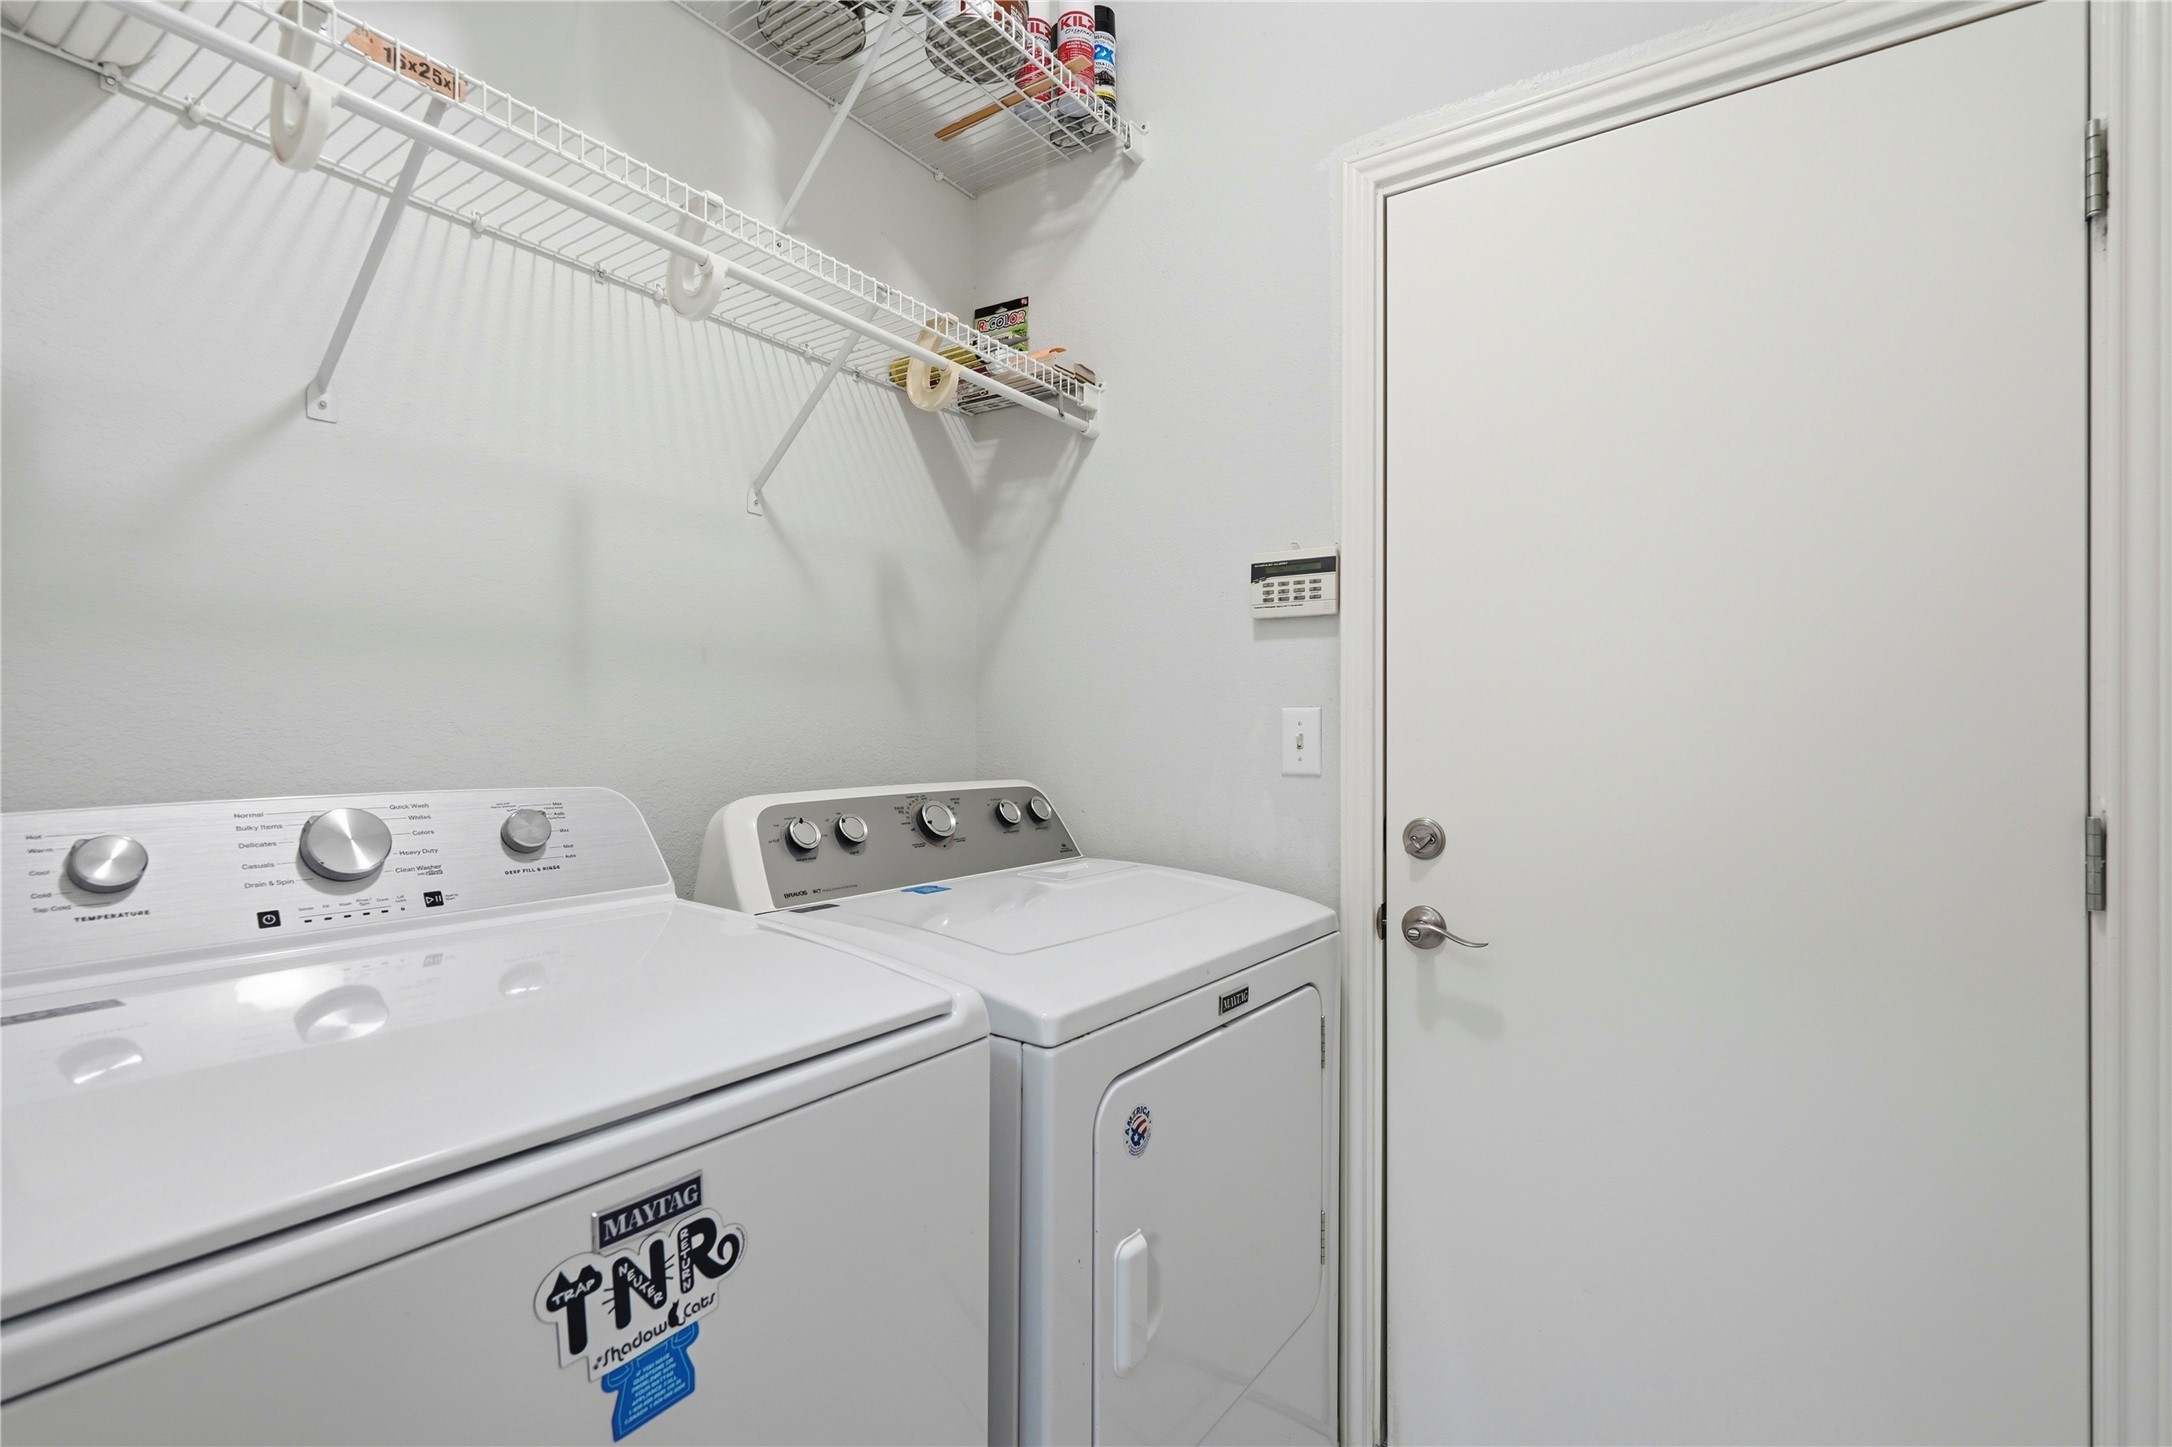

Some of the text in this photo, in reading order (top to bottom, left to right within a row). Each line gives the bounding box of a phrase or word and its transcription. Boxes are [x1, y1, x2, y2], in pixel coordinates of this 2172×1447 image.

[238, 841, 277, 849] Delicates
[241, 862, 275, 870] Casuals
[275, 879, 295, 887] Spin
[74, 909, 150, 922] TEMPERATURE
[1223, 989, 1249, 1011] MAYTAG
[603, 1184, 699, 1243] MAYTAG
[680, 1228, 692, 1291] RETURN
[551, 1278, 596, 1305] TRAP
[617, 1262, 664, 1305] NEUTER
[603, 1292, 716, 1367] Shadow Cats
